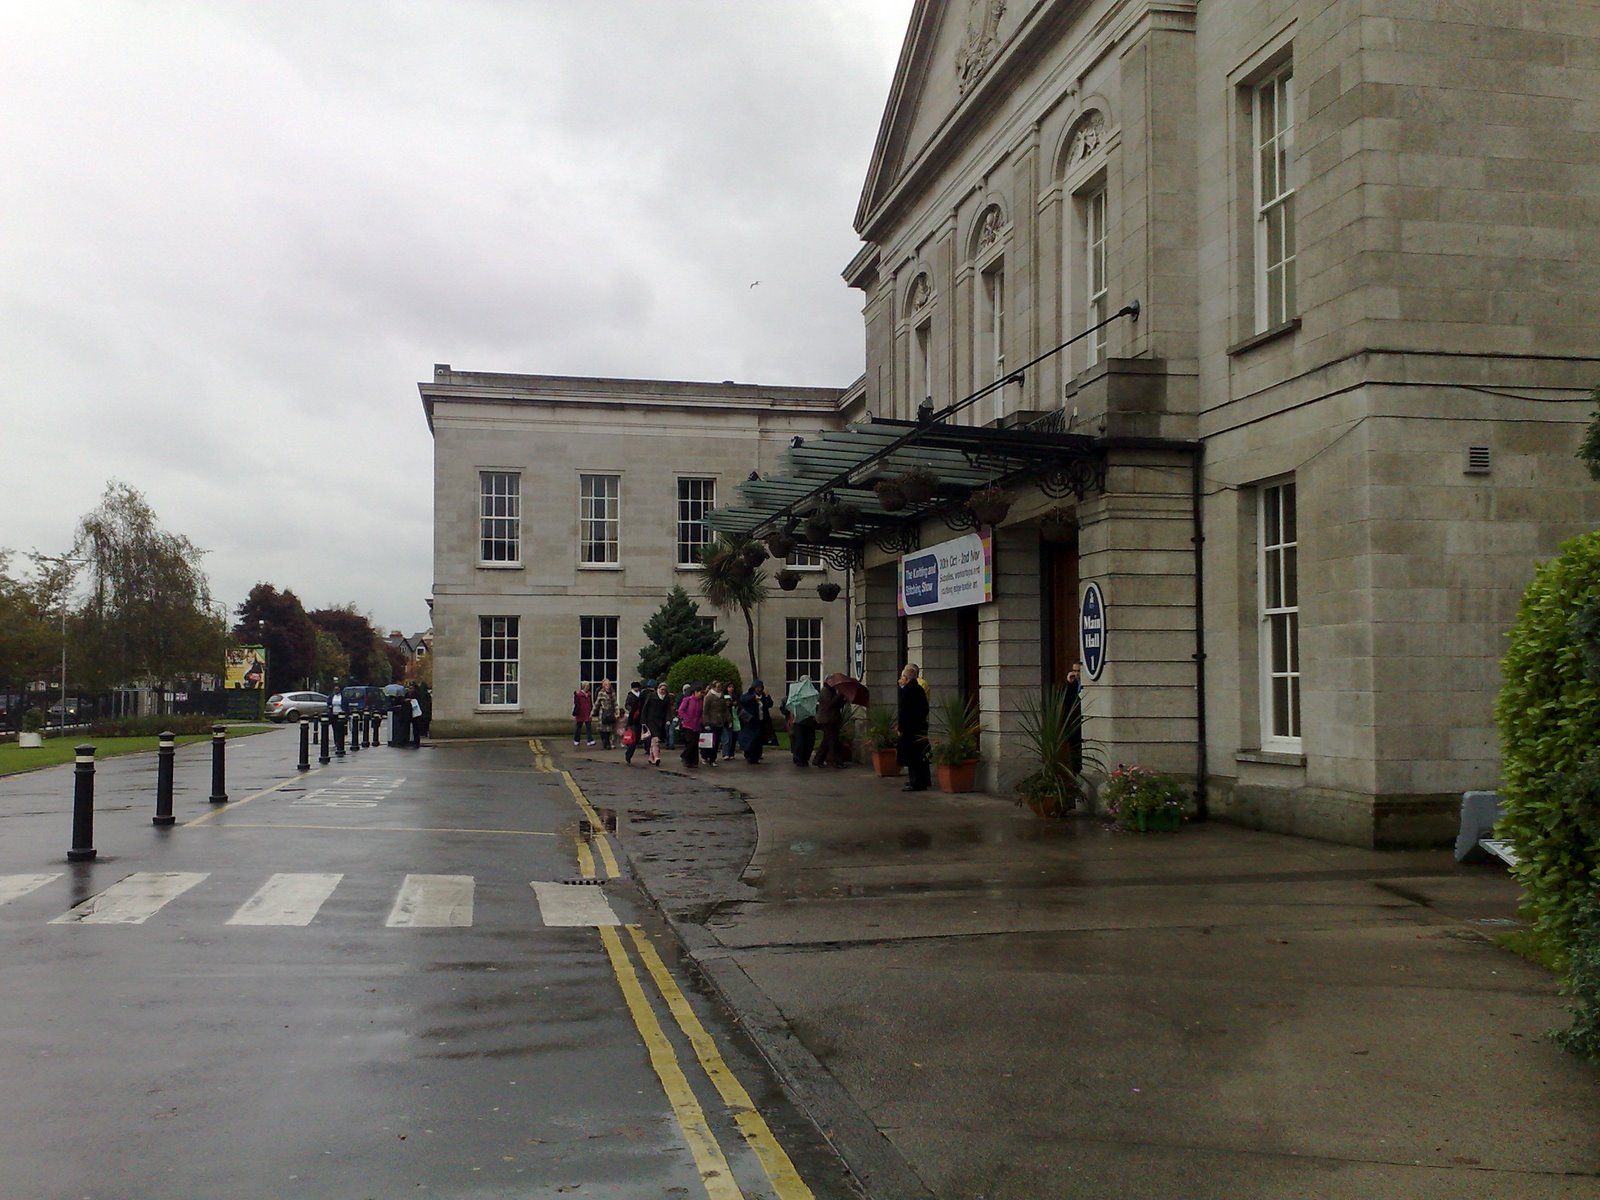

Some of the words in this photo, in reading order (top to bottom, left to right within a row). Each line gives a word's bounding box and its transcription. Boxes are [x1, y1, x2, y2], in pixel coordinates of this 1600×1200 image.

[950, 555, 958, 567] Oct
[961, 550, 970, 564] 2nd
[970, 550, 980, 562] Nov
[912, 566, 928, 578] Knitting
[928, 562, 936, 576] and
[906, 584, 922, 596] Stitching
[922, 582, 934, 593] Show
[1084, 614, 1100, 630] Main
[1085, 633, 1100, 648] Hall
[1090, 656, 1095, 670] 1
